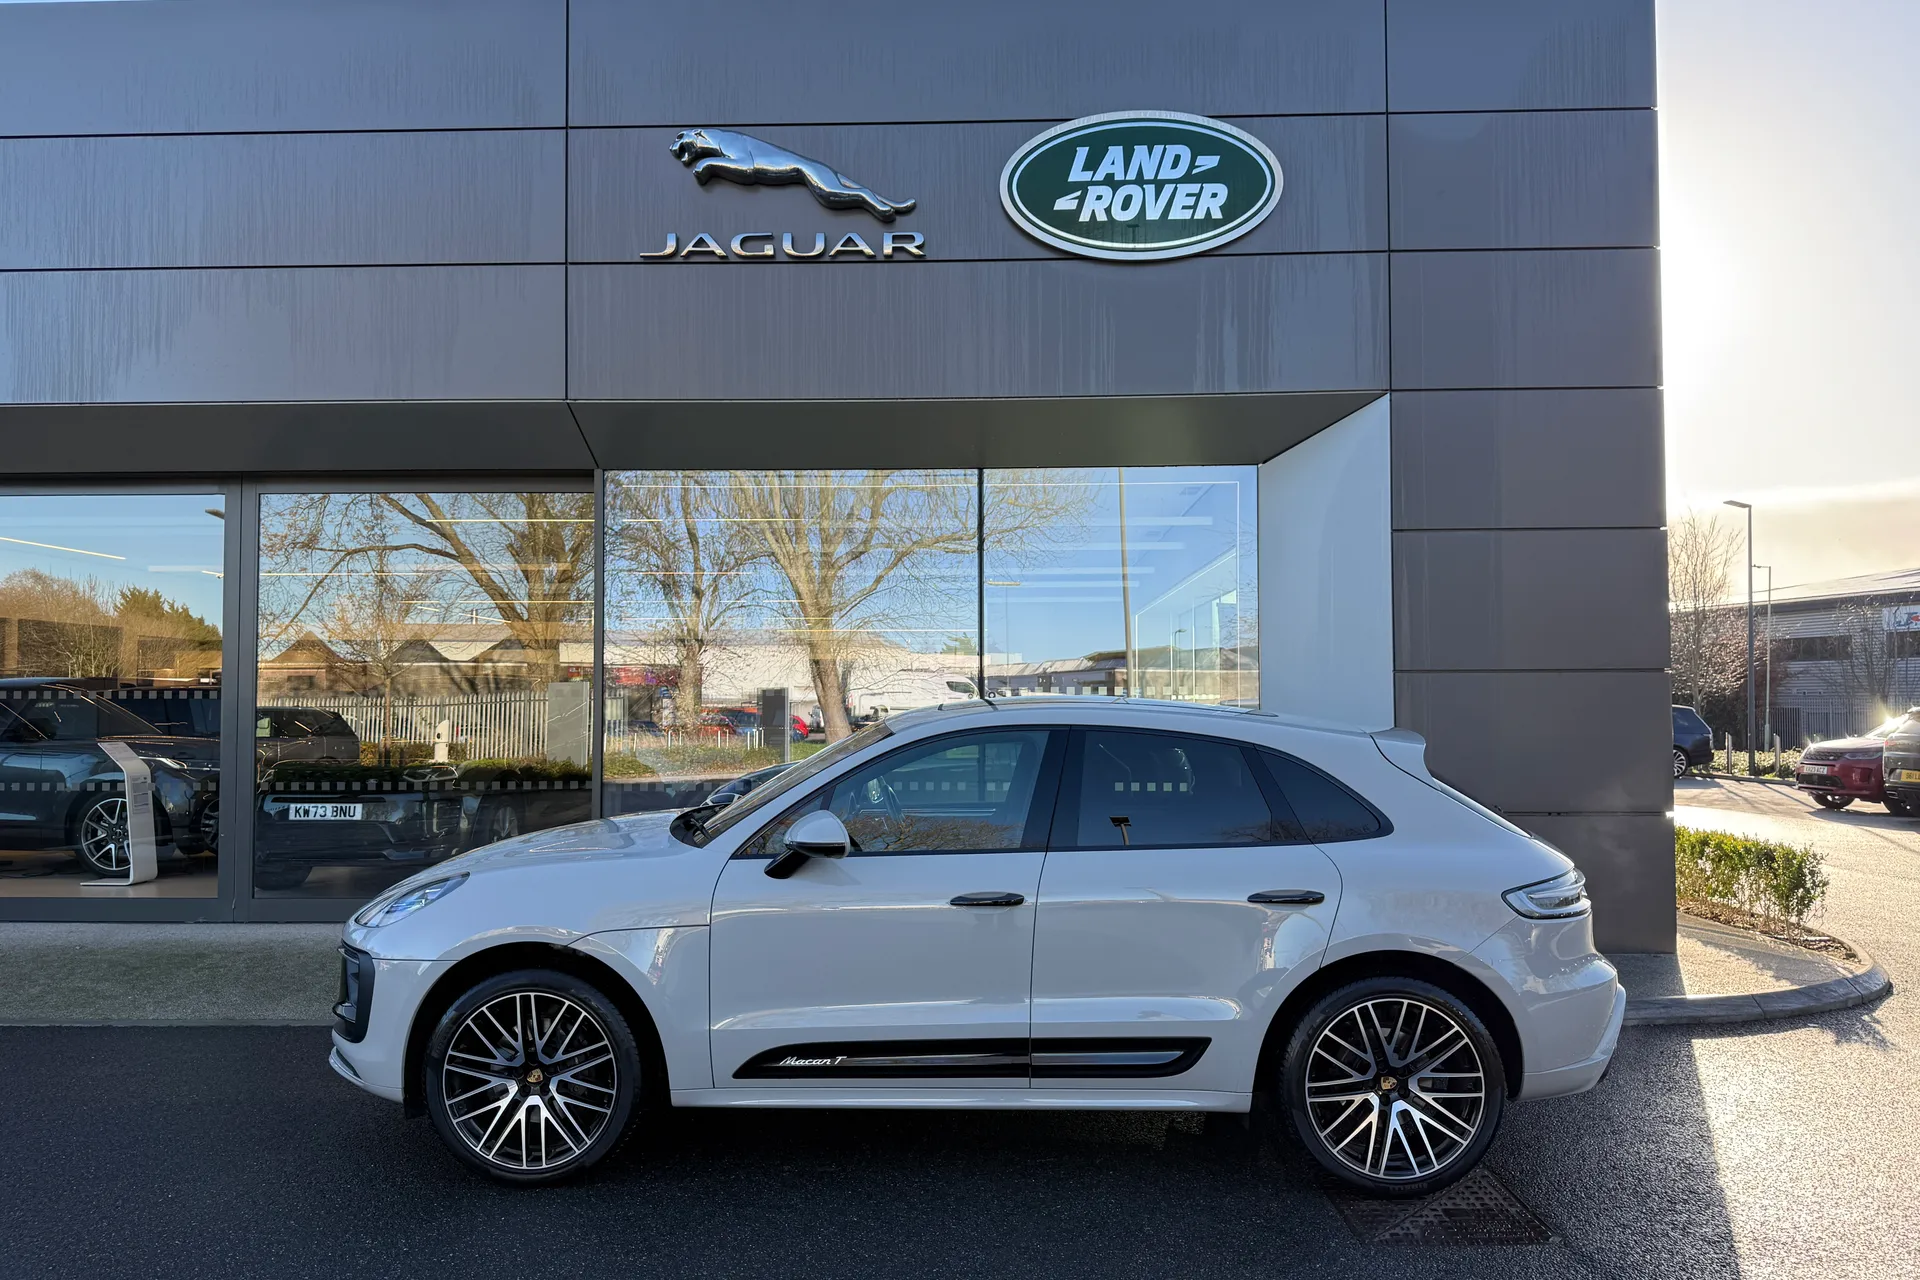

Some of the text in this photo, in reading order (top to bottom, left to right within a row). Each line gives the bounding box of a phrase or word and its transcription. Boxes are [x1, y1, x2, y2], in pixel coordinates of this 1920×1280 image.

[1067, 144, 1192, 182] LAND
[1078, 183, 1228, 222] ROVER
[639, 232, 926, 258] JAGUAR
[294, 805, 357, 818] KW73 BNU
[779, 1055, 848, 1066] Macan T
